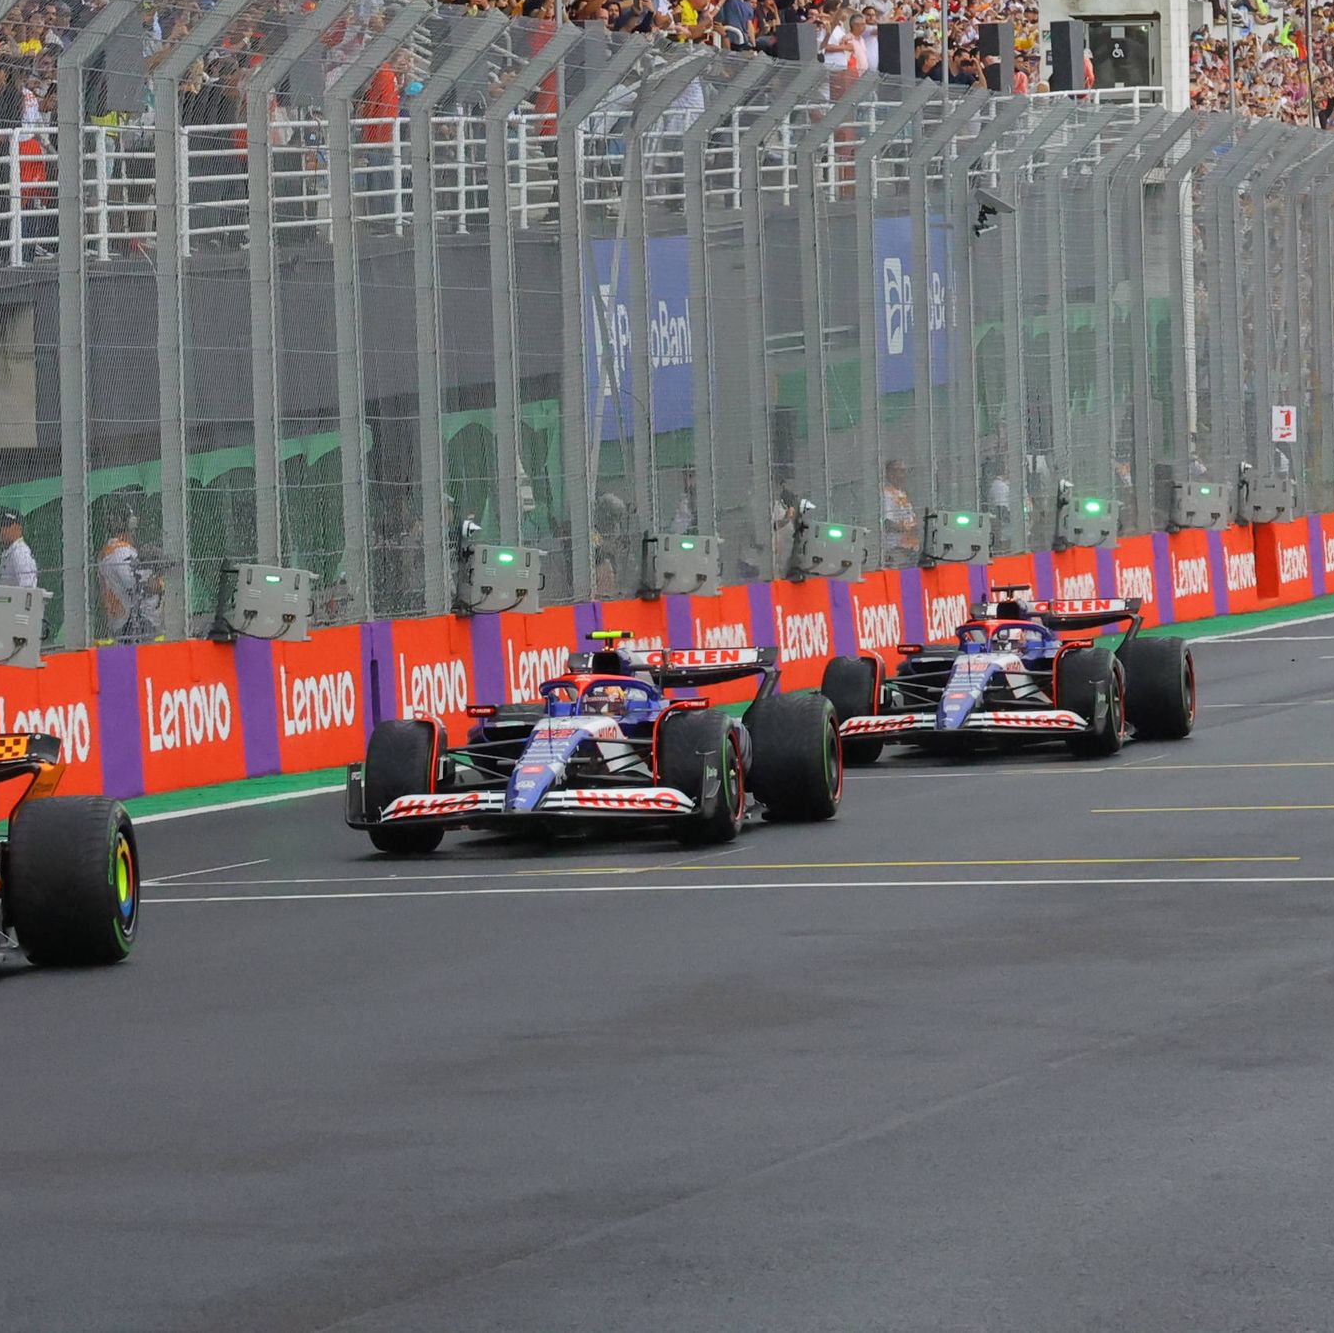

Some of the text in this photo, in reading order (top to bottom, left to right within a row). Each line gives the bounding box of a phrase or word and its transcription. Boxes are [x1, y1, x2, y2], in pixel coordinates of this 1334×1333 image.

[1172, 551, 1209, 599] Lenovo
[1277, 541, 1308, 584] Lenovo
[853, 595, 901, 650] Lenovo
[925, 588, 968, 642] Lenovo
[1034, 599, 1112, 613] ORLEN
[646, 649, 740, 666] ORLEN
[776, 605, 829, 663] Lenovo
[400, 653, 468, 720] Lenovo
[507, 638, 571, 704] Lenovo
[145, 677, 231, 752] Lenovo
[280, 664, 356, 737] Lenovo
[992, 711, 1075, 728] HUGO
[393, 793, 481, 818] HUGO
[576, 789, 679, 811] HUGO
